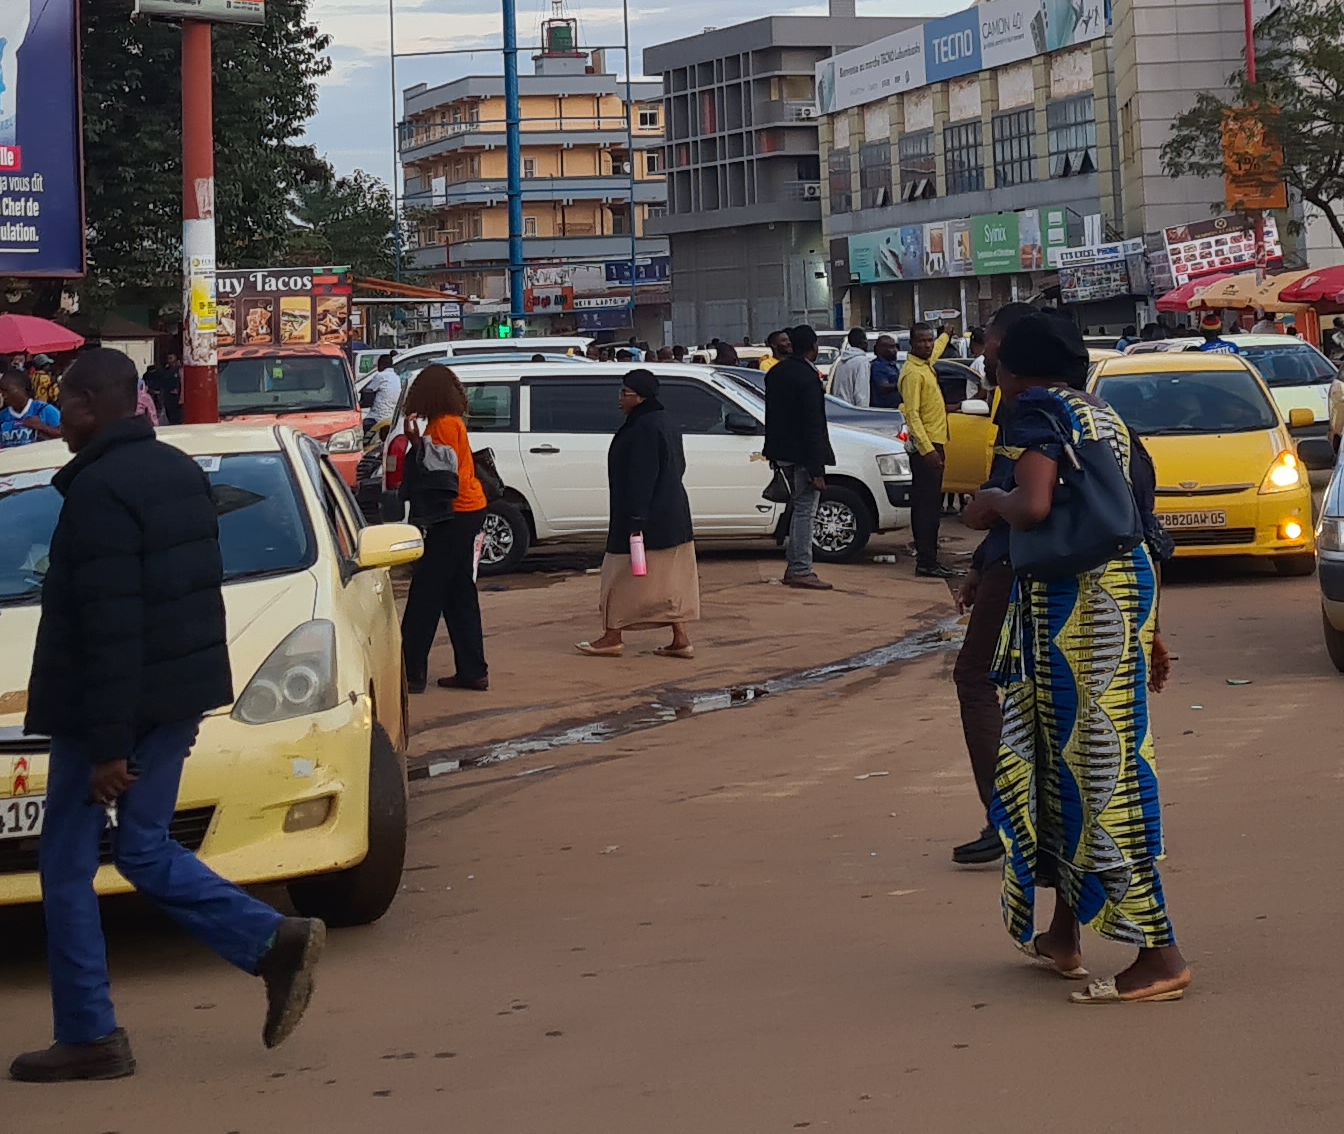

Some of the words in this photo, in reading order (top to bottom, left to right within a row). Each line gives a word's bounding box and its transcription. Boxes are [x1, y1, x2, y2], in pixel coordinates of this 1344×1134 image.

[982, 15, 1011, 39] CAMON
[931, 29, 973, 65] TECNO
[8, 176, 30, 192] vous
[31, 172, 44, 193] dit
[2, 197, 25, 217] Chef
[26, 199, 39, 217] de
[215, 274, 244, 298] uy
[249, 271, 312, 292] Tacos
[1210, 512, 1225, 525] 05
